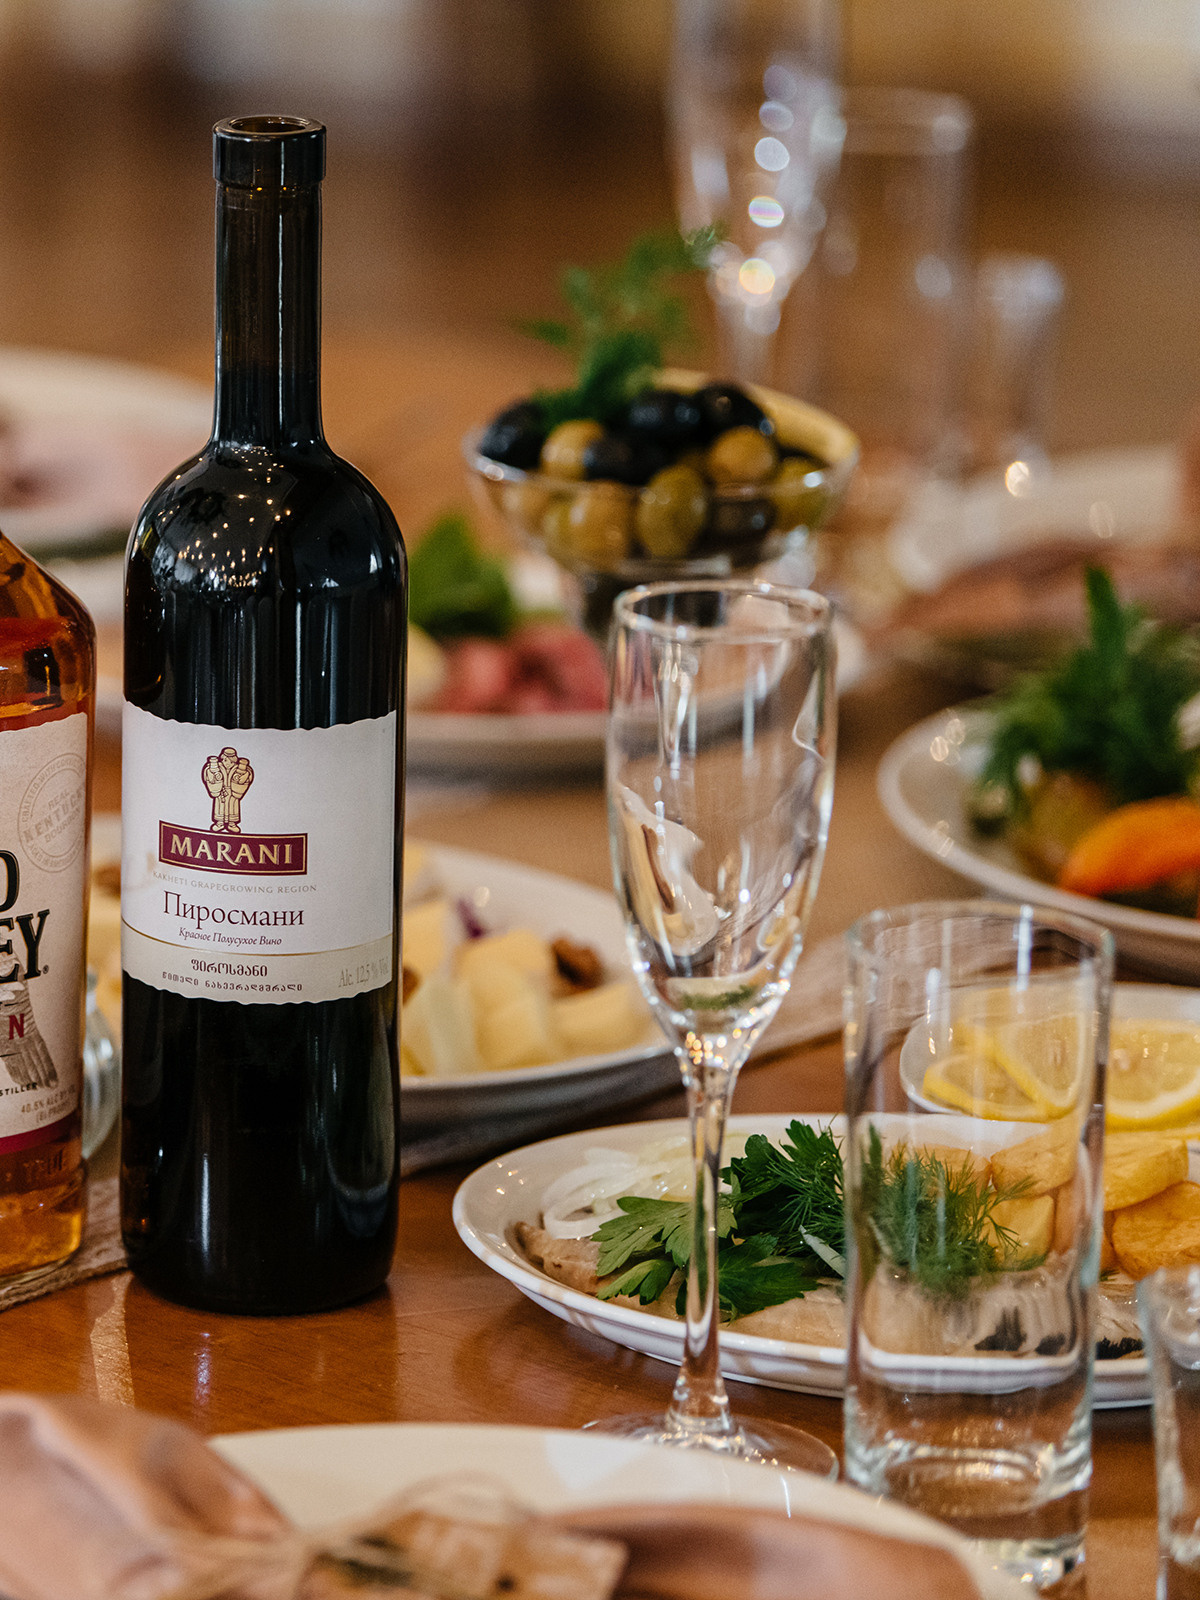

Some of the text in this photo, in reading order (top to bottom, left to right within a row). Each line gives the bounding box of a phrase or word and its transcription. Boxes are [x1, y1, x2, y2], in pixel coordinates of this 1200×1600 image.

[170, 834, 293, 866] MARANI
[152, 871, 317, 894] KAKHETI GRAPEGROWING REGION
[163, 890, 305, 931] Пиросмани
[179, 926, 282, 947] Красное Полусухое Вино
